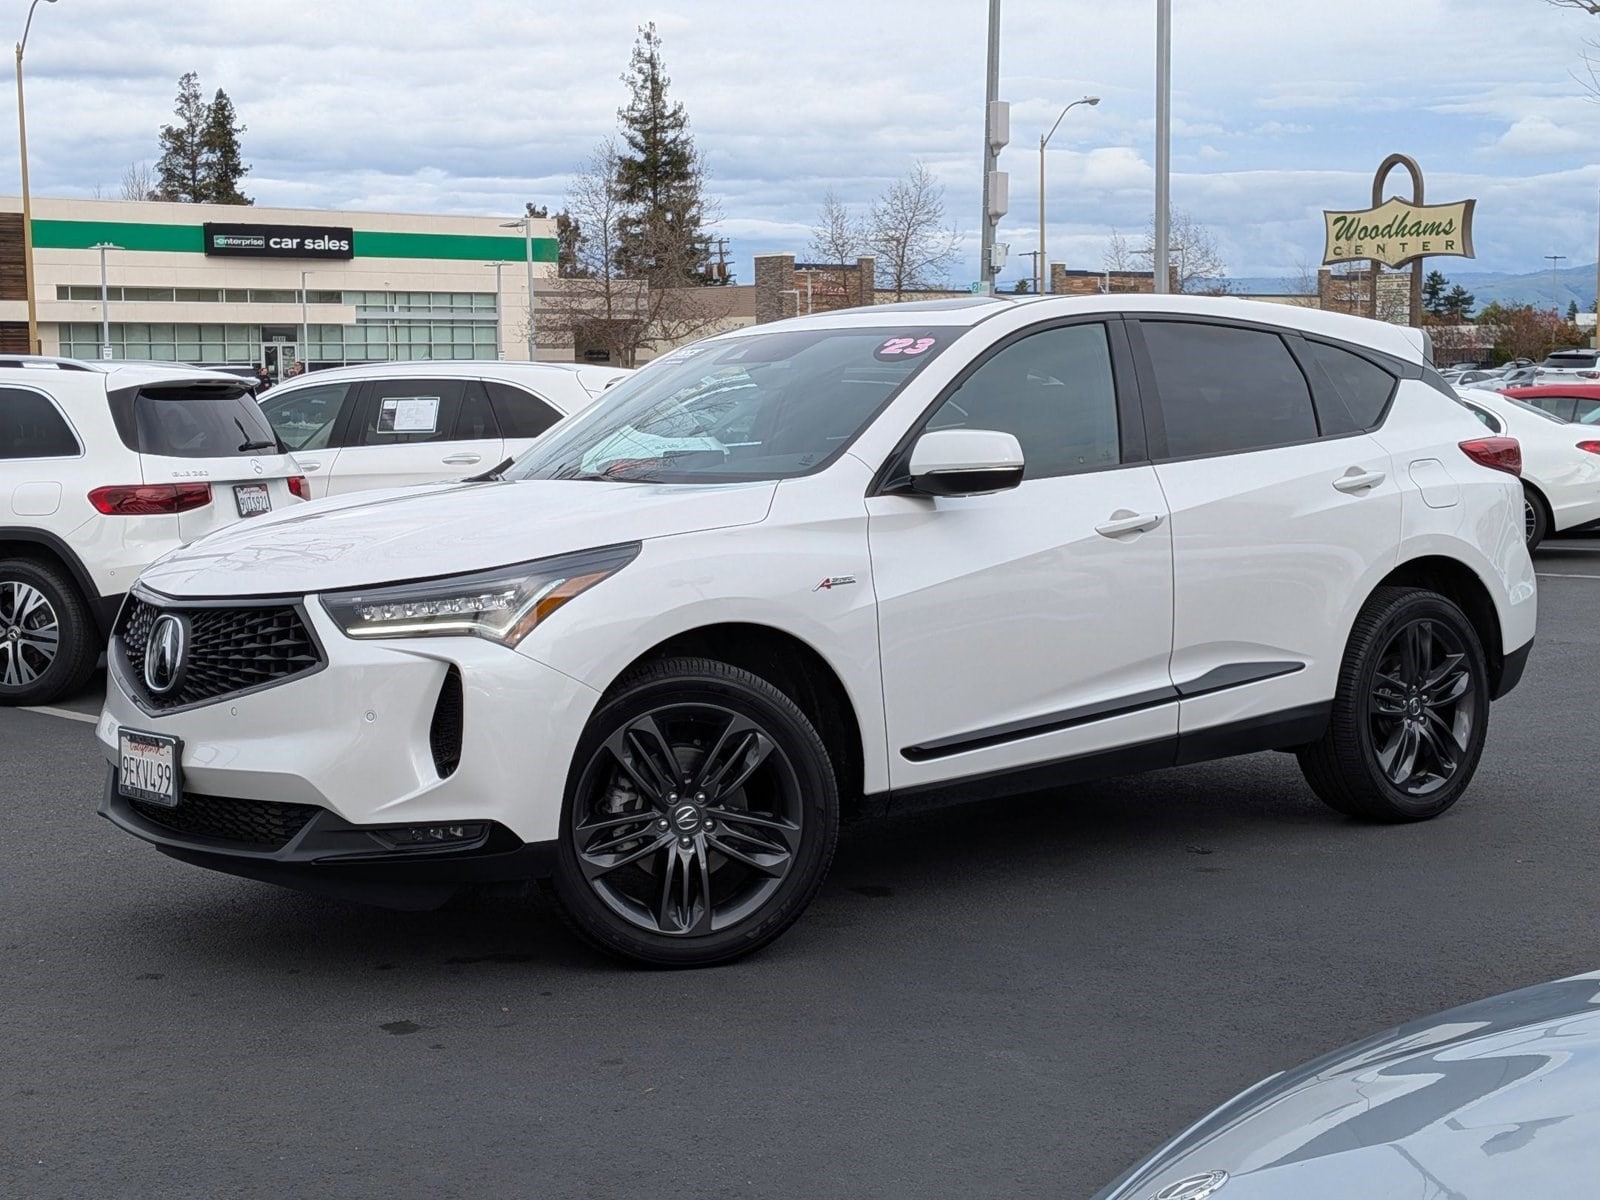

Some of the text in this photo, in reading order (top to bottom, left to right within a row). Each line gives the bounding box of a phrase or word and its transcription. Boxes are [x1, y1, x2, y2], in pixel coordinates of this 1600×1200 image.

[1333, 210, 1456, 242] Woodhams
[215, 235, 349, 250] enterprise car sales
[1333, 240, 1455, 256] CENTER
[122, 755, 172, 795] 9EKV499
